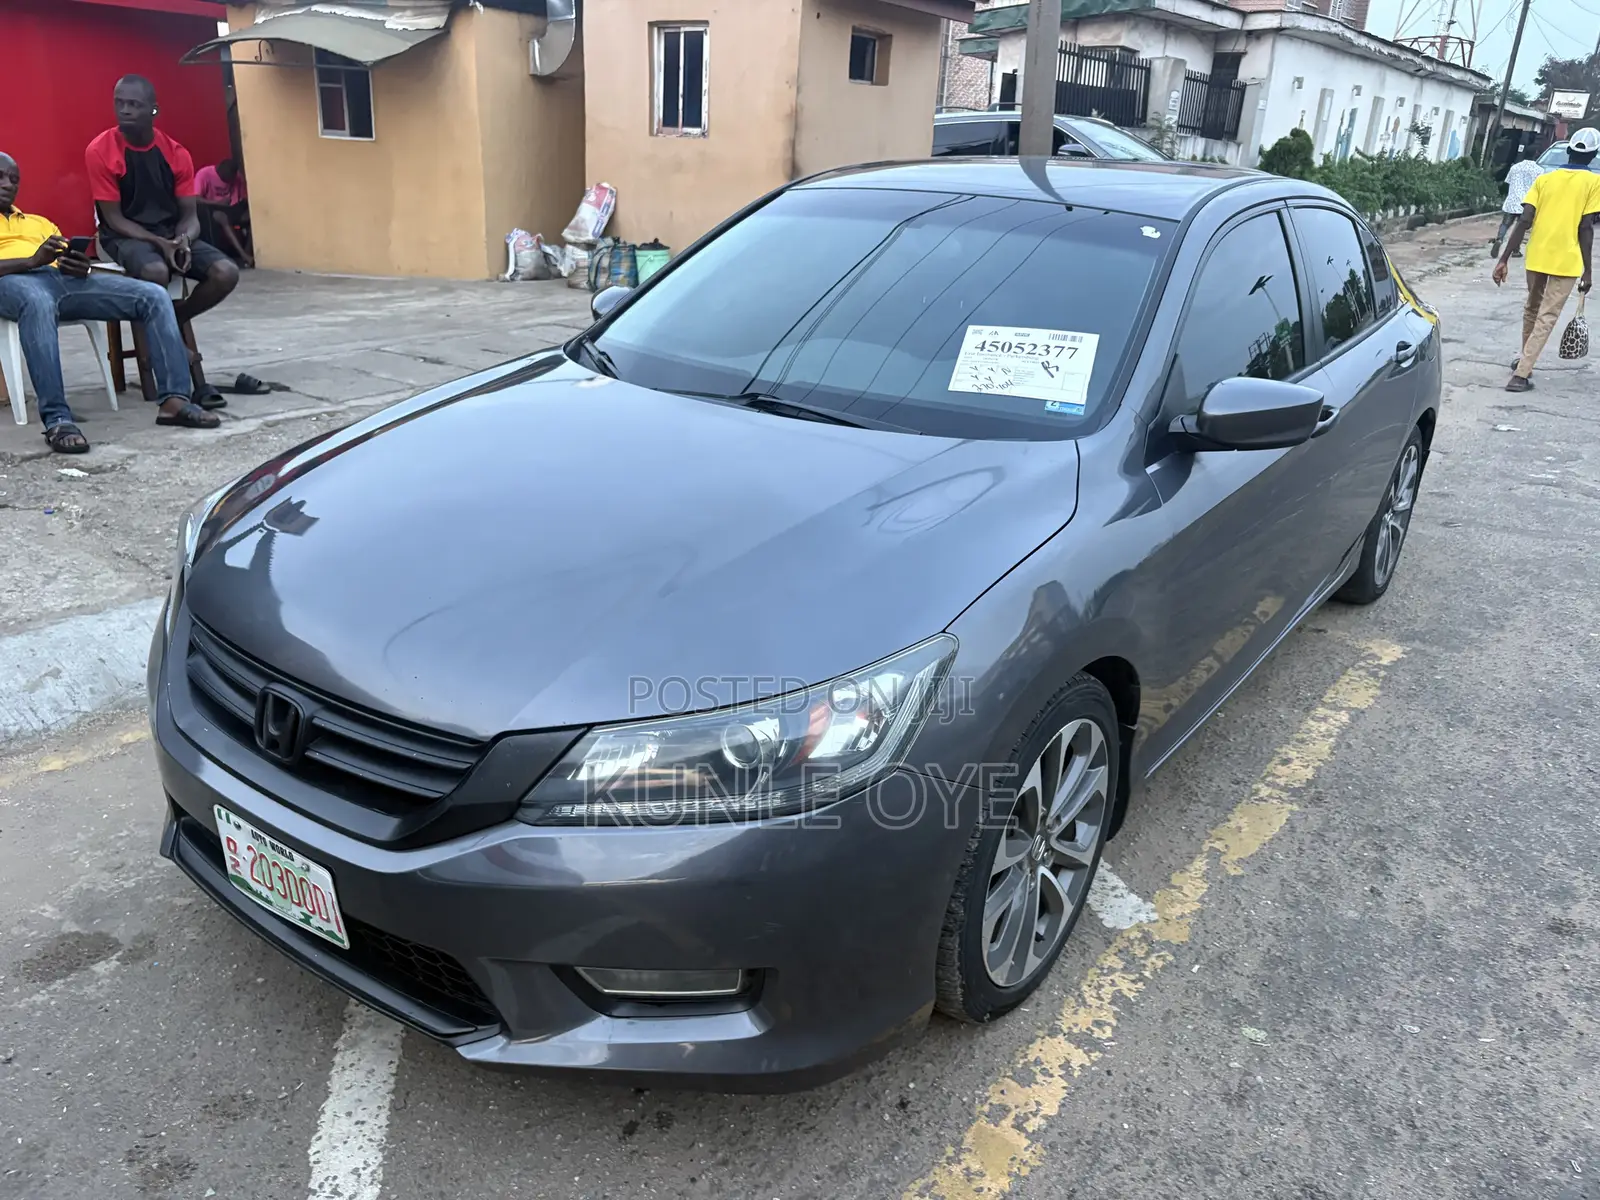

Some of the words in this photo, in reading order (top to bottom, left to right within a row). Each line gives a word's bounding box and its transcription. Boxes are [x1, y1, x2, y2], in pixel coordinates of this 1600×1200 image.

[974, 340, 1079, 359] 45052377
[250, 829, 267, 847] AUTO
[269, 840, 294, 862] WORLD
